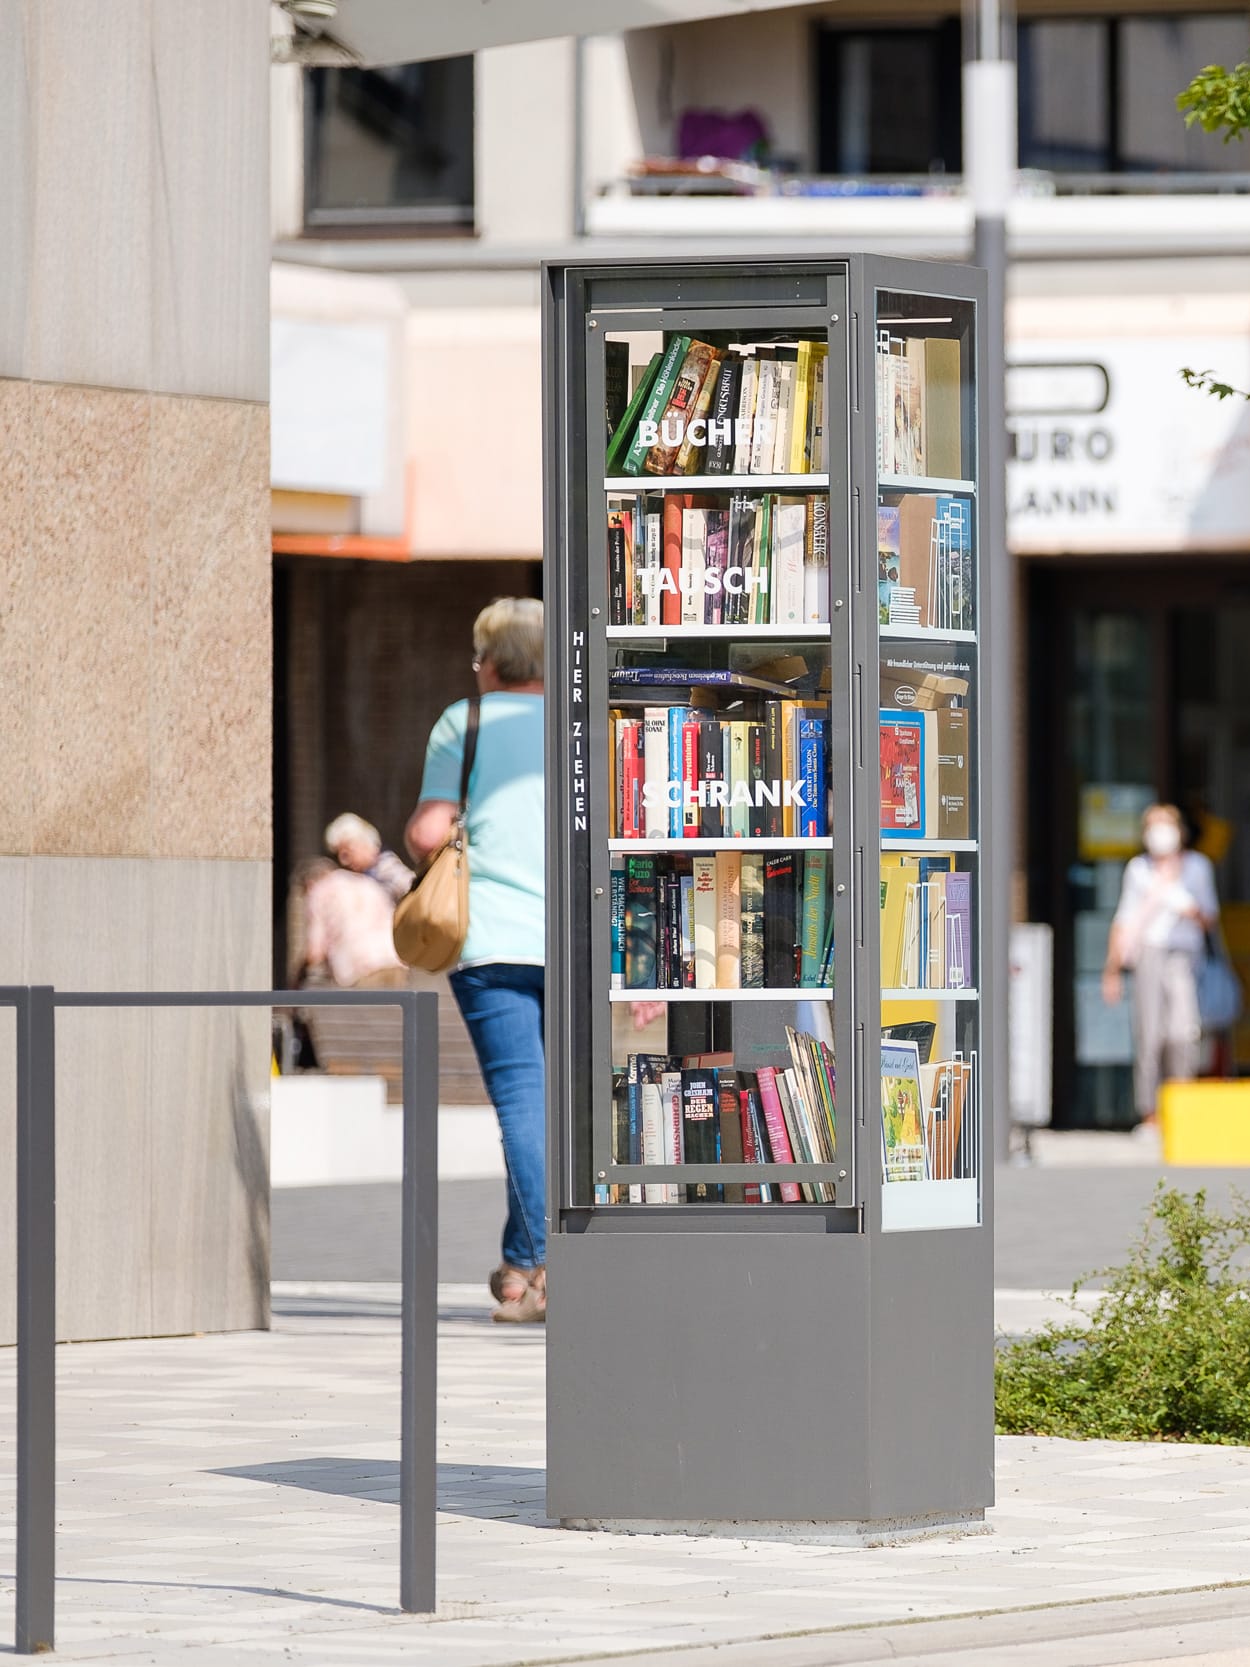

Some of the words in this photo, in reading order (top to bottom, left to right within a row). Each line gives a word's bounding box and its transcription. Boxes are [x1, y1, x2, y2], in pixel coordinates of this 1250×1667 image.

[658, 336, 682, 383] Höhlenkinder
[656, 383, 666, 396] Die
[639, 411, 772, 447] BÜCHER
[1013, 430, 1113, 462] URO
[814, 502, 826, 554] KONSALIK
[637, 567, 769, 594] TAUSCH
[573, 631, 584, 703] HIER
[654, 673, 688, 681] Botschaften
[688, 672, 717, 681] geheimen
[717, 672, 727, 681] Die
[572, 722, 587, 831] ZIEHEN
[641, 779, 808, 808] SCHRANK
[629, 858, 654, 869] Mario
[629, 869, 650, 878] Puzo
[766, 858, 779, 867] CALEB
[780, 855, 792, 863] CARR
[804, 873, 820, 903] Nacht
[805, 905, 818, 921] der
[802, 923, 819, 960] Jenseits
[683, 1088, 713, 1096] GRISHAM
[684, 1104, 714, 1113] REGEN
[671, 1095, 681, 1165] GEHIRNSTATI
